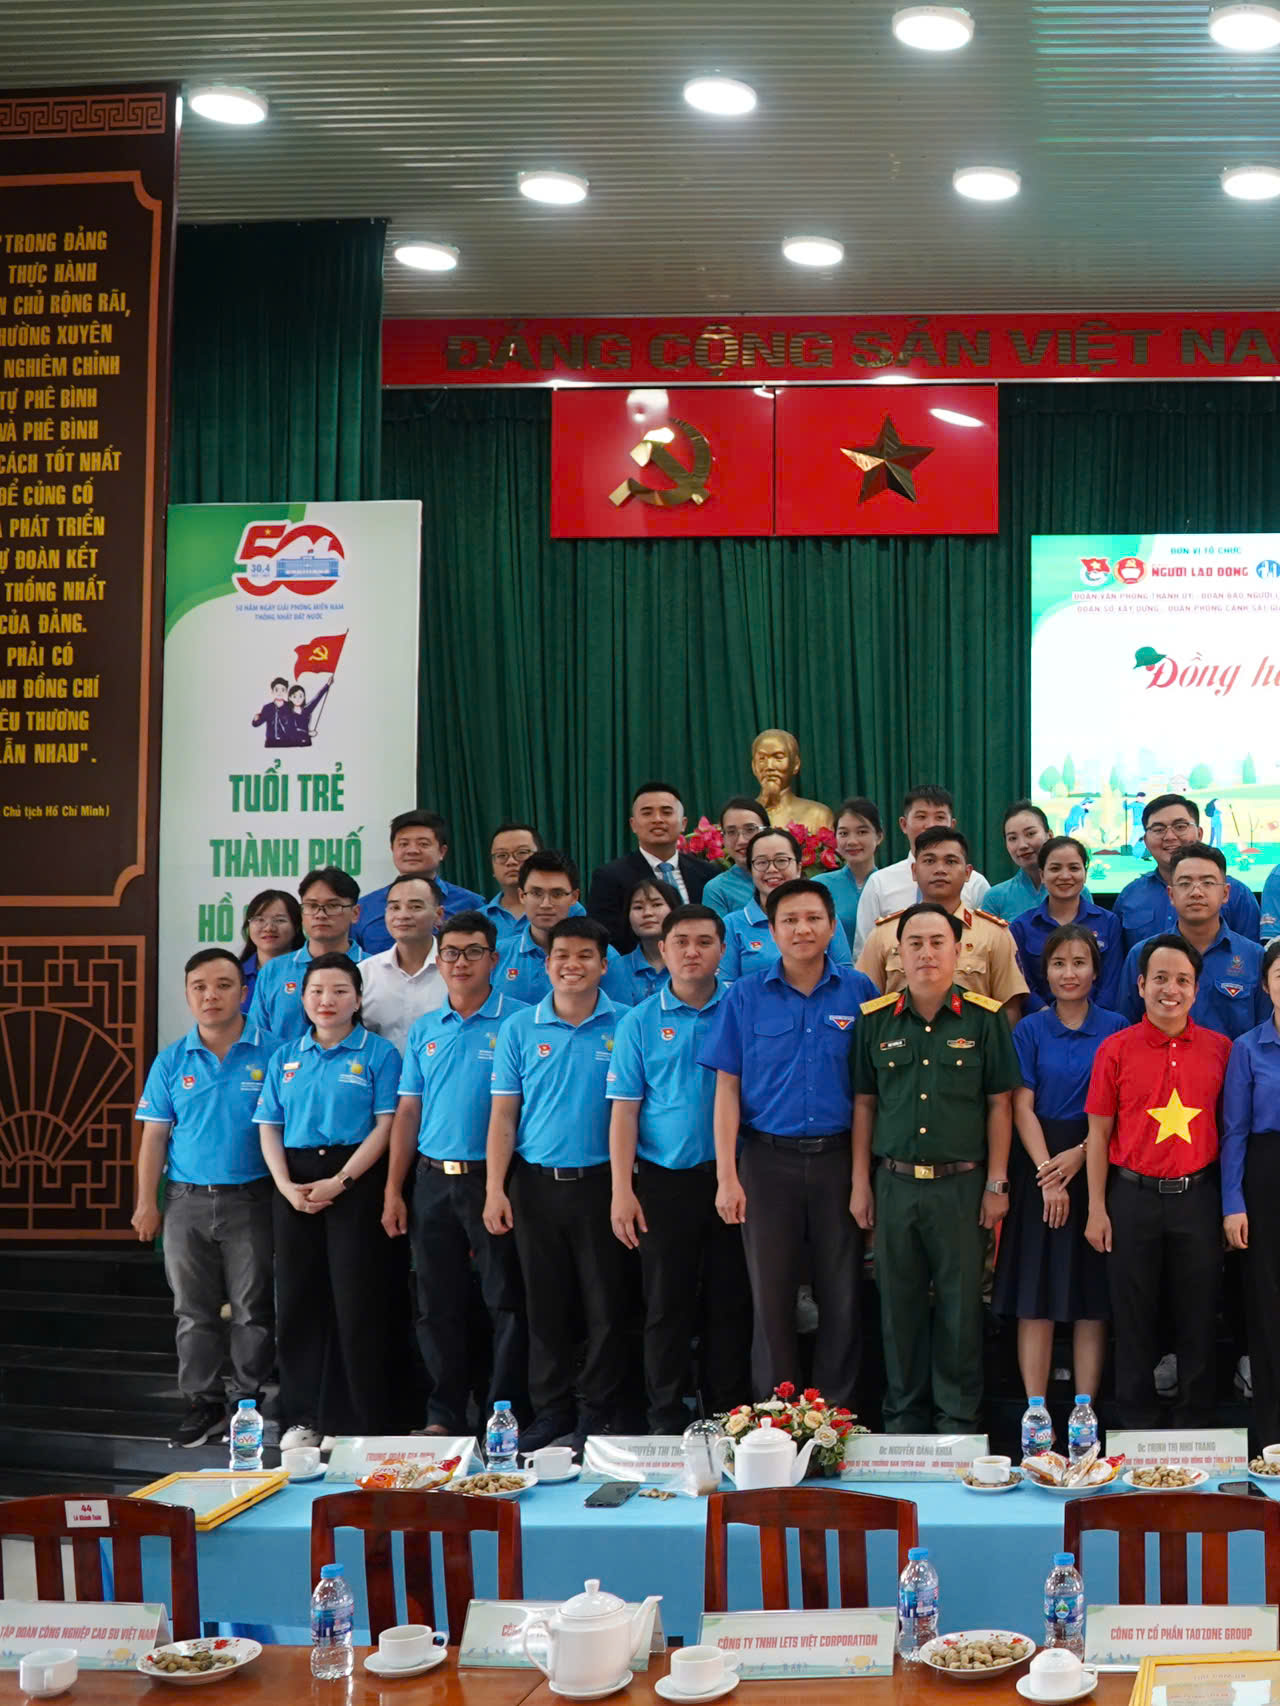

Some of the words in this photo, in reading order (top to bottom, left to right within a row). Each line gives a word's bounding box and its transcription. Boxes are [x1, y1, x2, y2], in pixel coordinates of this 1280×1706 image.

[64, 225, 107, 251] ĐẢNG
[8, 262, 48, 288] THỰC
[54, 260, 98, 283] HÀNH
[14, 290, 45, 315] CHỦ
[50, 290, 93, 317] RỘNG
[98, 289, 131, 317] RÃI,
[57, 320, 112, 345] XUYÊN
[446, 318, 632, 371] ĐẢNG
[651, 324, 834, 376] CỘNG
[852, 318, 990, 370] SẢN
[1006, 321, 1163, 372] VIỆT
[4, 353, 67, 378] NGHIÊM
[73, 350, 120, 376] CHỈNH
[0, 388, 18, 414] TỰ
[25, 385, 56, 410] PHÊ
[61, 385, 98, 409] BÌNH
[0, 419, 17, 442] VÀ
[23, 418, 55, 441] PHÊ
[60, 416, 99, 440] BÌNH
[45, 446, 75, 473] TỐT
[80, 444, 122, 472] NHẤT
[23, 480, 66, 506] CỦNG
[72, 477, 94, 505] CỐ
[10, 514, 50, 538] PHÁT
[57, 507, 105, 537] TRIỂN
[15, 545, 60, 570] ĐOÀN
[66, 540, 98, 569] KẾT
[5, 575, 57, 602] THỐNG
[63, 574, 106, 601] NHẤT
[38, 608, 88, 634] ĐẢNG.
[7, 640, 45, 667] PHẢI
[52, 641, 74, 666] CÓ
[23, 671, 68, 699] ĐỒNG
[72, 674, 100, 698] CHÍ
[1146, 651, 1243, 697] Đồng
[26, 708, 90, 731] THƯƠNG
[229, 757, 289, 813] TUỔI
[298, 762, 345, 812] TRẺ
[3, 804, 21, 818] Chủ
[25, 804, 43, 820] tịch
[45, 804, 59, 817] Hồ
[62, 804, 78, 817] Chí
[209, 832, 299, 878] THÀNH
[309, 826, 366, 877] PHỐ
[198, 891, 234, 943] HỒ
[80, 1504, 92, 1513] 44
[91, 1627, 107, 1641] CAO
[137, 1628, 157, 1641] NAM
[718, 1635, 741, 1651] CÔNG
[743, 1637, 754, 1650] TY
[755, 1636, 778, 1649] TNHH
[779, 1635, 798, 1649] LETS
[800, 1633, 819, 1651] VIỆT
[820, 1633, 879, 1648] CORPORATION
[1110, 1626, 1134, 1641] CÔNG
[1136, 1627, 1146, 1641] TY
[1160, 1623, 1184, 1641] PHẦN
[1224, 1627, 1253, 1641] GROUP
